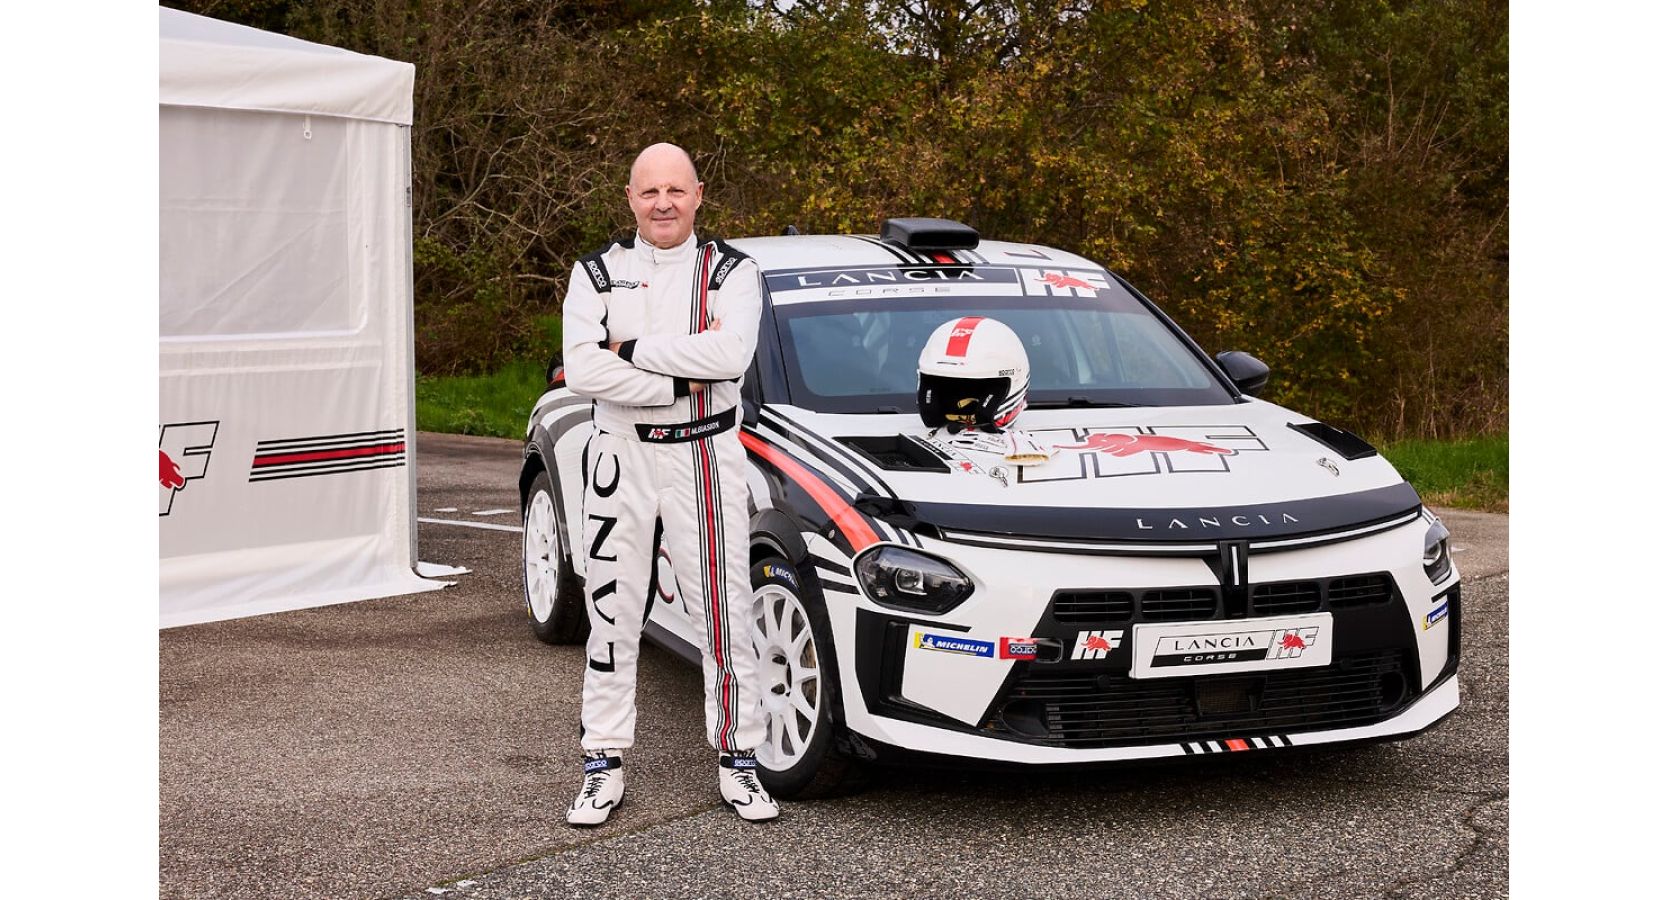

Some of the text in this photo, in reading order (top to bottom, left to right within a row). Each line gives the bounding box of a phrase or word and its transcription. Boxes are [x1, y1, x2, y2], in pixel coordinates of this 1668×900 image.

[797, 270, 985, 287] LANCIA
[828, 286, 951, 297] CORSE
[1136, 512, 1299, 530] LANCIA
[936, 640, 989, 653] MICHELIN
[1174, 636, 1255, 651] LANCIA
[1183, 653, 1238, 662] CORSE
